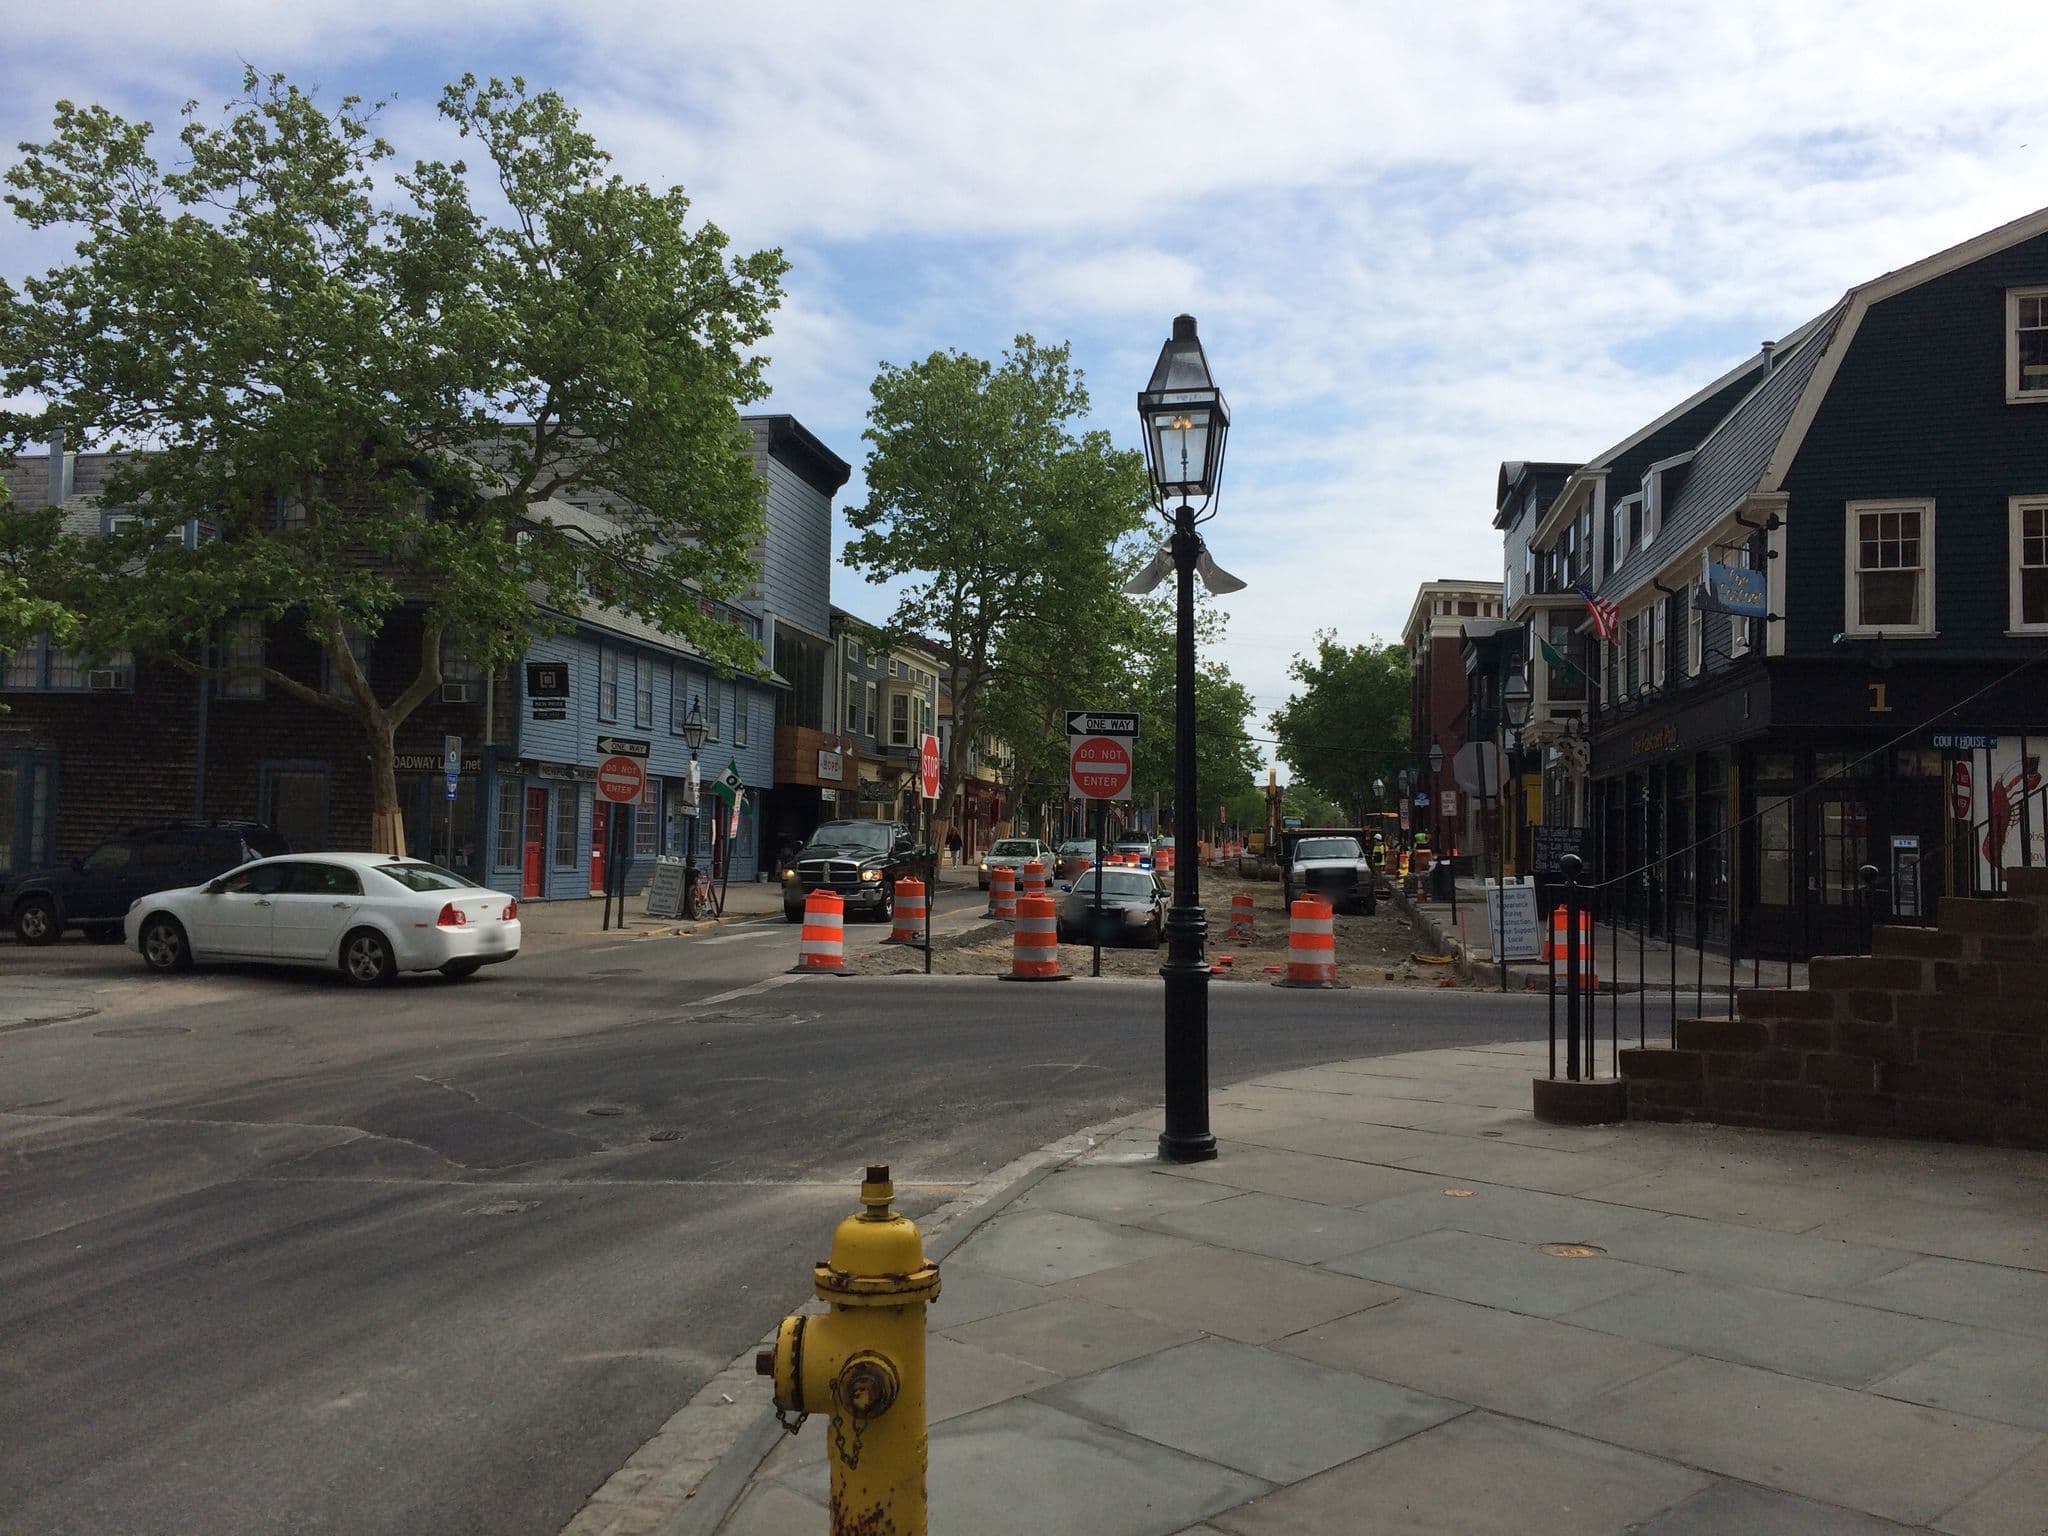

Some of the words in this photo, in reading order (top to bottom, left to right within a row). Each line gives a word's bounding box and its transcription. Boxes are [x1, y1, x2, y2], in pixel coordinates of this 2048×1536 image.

[1868, 683, 1893, 713] 1
[1086, 719, 1106, 729] ONE
[1111, 719, 1131, 730] WAY
[611, 742, 626, 751] ONE
[629, 744, 645, 753] WAY
[1933, 735, 1987, 748] COUTHOUSE
[1080, 749, 1095, 759] DO
[1101, 749, 1122, 760] NOT
[392, 755, 435, 769] OADWAY
[923, 754, 940, 778] STOP
[606, 762, 617, 772] DO
[621, 764, 638, 775] NOT
[1083, 776, 1118, 787] ENTER
[606, 783, 634, 795] ENTER
